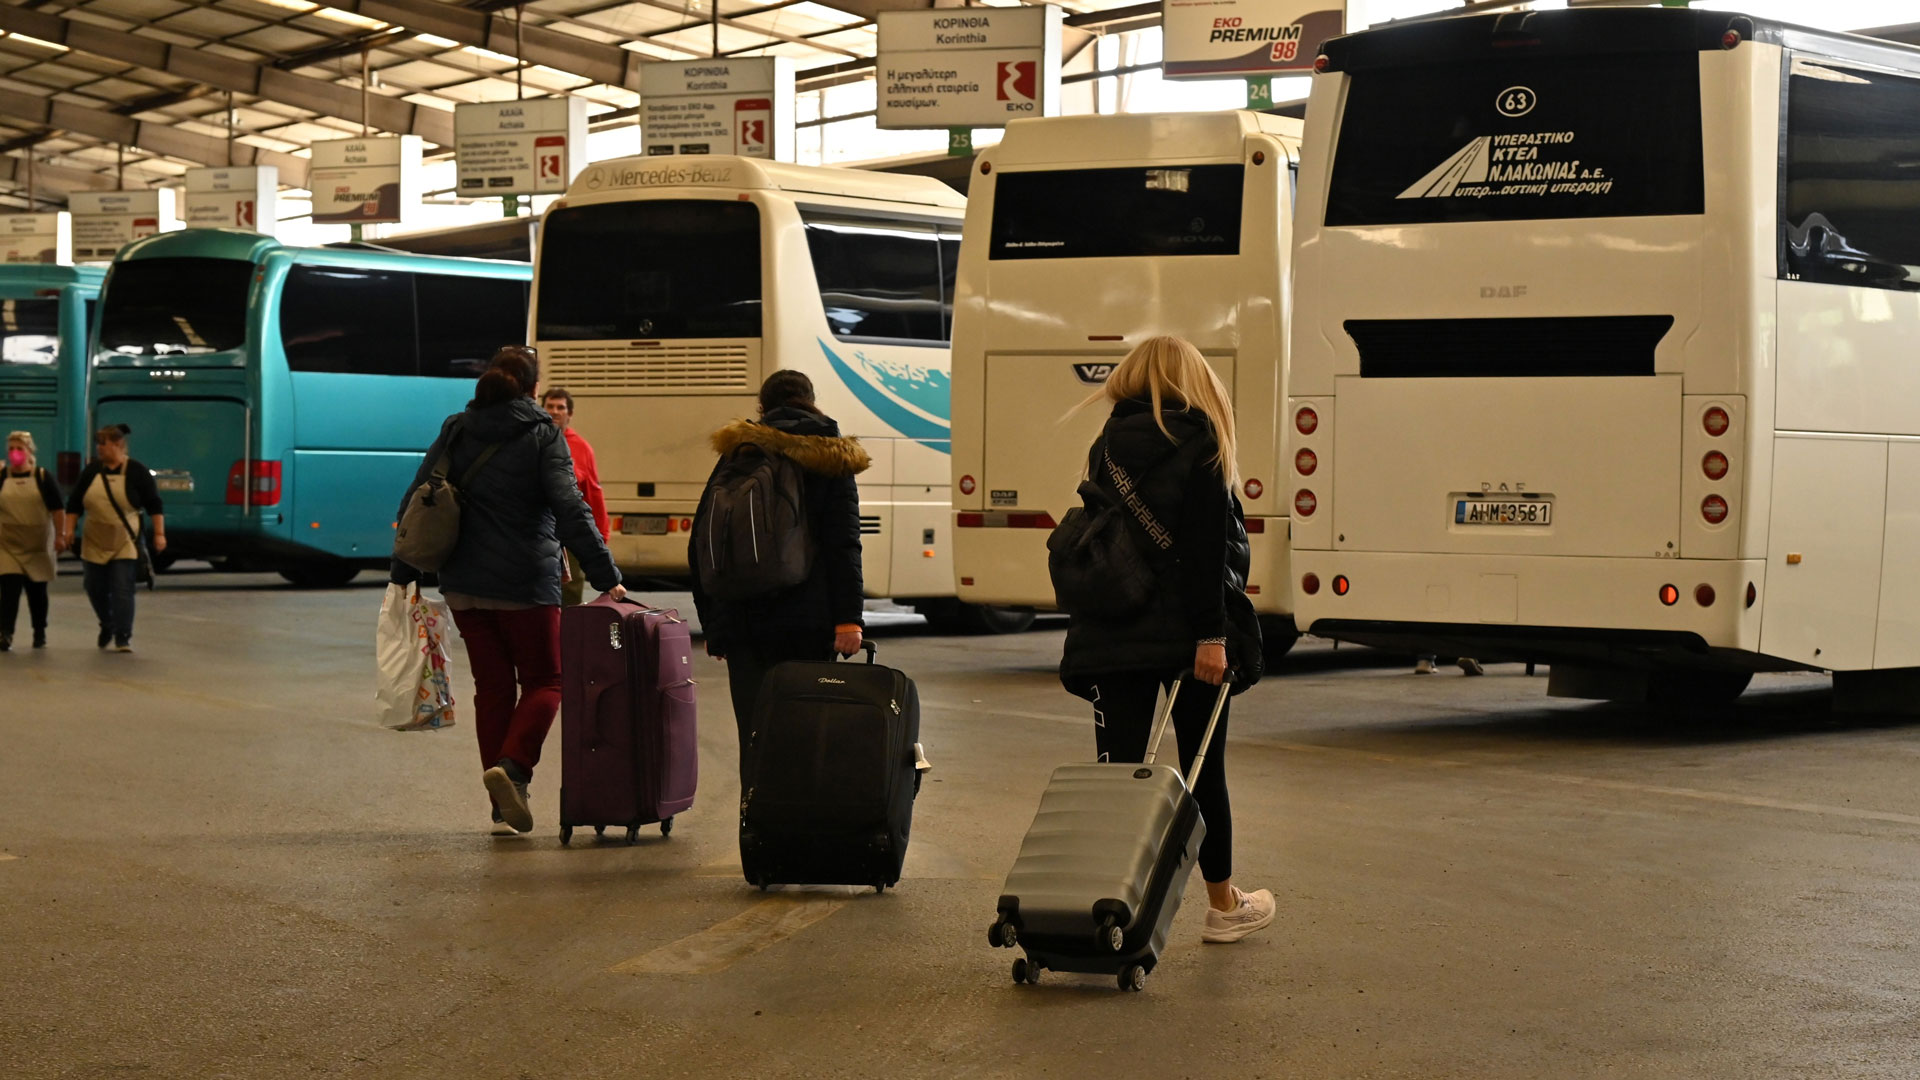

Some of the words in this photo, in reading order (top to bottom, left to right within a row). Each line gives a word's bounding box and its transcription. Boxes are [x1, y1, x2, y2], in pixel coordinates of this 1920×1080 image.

[933, 17, 990, 29] ΚΟΡΙΝΘΙΑ
[1213, 17, 1243, 28] EKO
[936, 33, 987, 44] Korinthia
[1209, 26, 1300, 43] PREMIUM
[1271, 41, 1297, 60] 98
[684, 67, 730, 77] ΚΟΡΙΝΘΙΑ
[897, 69, 958, 83] μεγαλύτερη
[686, 81, 728, 91] Korinthia
[887, 82, 934, 95] ελληνική
[936, 82, 980, 95] εταιρεία
[1249, 84, 1269, 100] 24
[1006, 102, 1034, 111] EKO
[1504, 92, 1527, 111] 63
[951, 134, 969, 148] 25
[1493, 131, 1575, 147] ΥΠΕΡΑΣΤΙΚΟ
[1492, 147, 1538, 161] ΚΤΕΛ
[608, 164, 732, 187] Mercedes-Benz
[1488, 160, 1580, 182] Ν.ΛΑΚΩΝΙΑΣ
[1580, 168, 1605, 179] Α.Ε.
[1550, 178, 1614, 195] υπεροχή
[333, 192, 379, 203] PREMIUM
[1480, 285, 1528, 298] DAF
[1480, 482, 1526, 493] DAF
